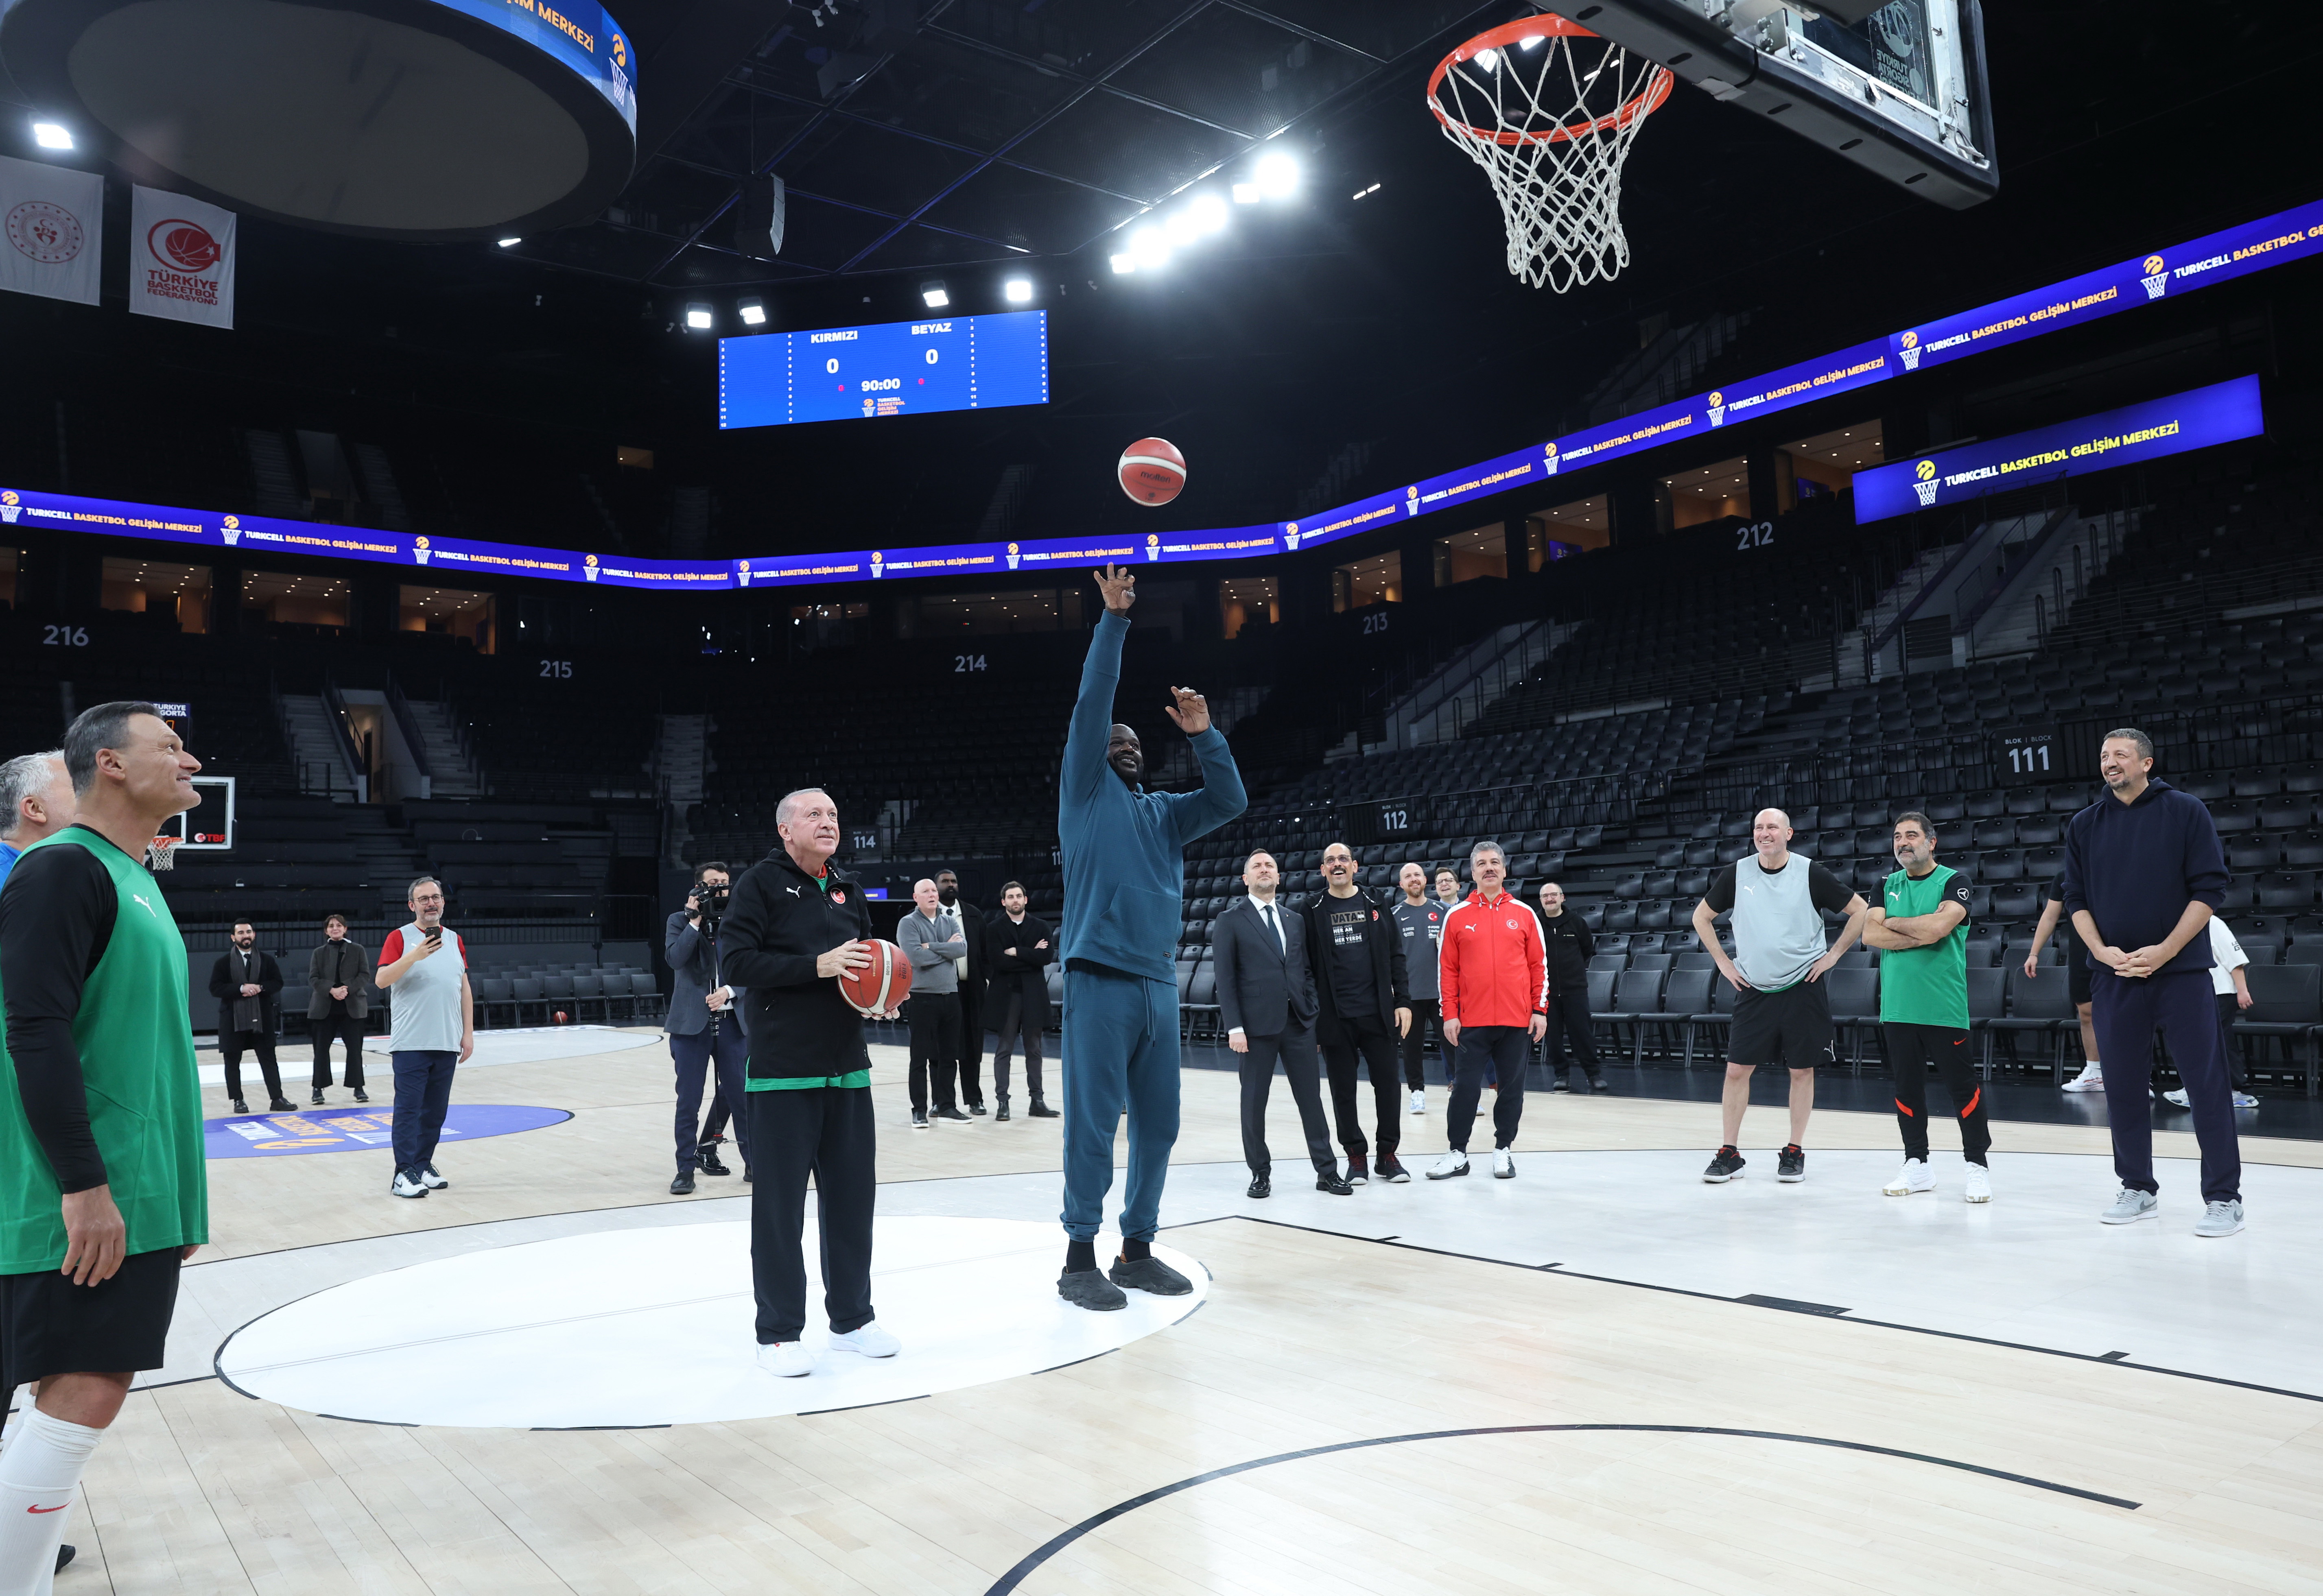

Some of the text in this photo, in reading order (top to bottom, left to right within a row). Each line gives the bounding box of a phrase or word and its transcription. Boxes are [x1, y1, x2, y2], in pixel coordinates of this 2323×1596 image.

[538, 2, 594, 53] MERKEZİ
[2174, 253, 2231, 278] TURKCELL
[2233, 231, 2306, 261] BASKETBOL
[148, 269, 218, 291] TÜRKİYE
[148, 280, 218, 299] BASKETBOL
[148, 288, 218, 306] FEDERASYONU
[911, 322, 952, 335] BEYAZ
[1925, 286, 2118, 353] TURKCELL BASKETBOL GELİŞİM MERKEZİ
[811, 330, 858, 343] KIRMIZI
[826, 358, 839, 374] 0
[925, 349, 938, 365] 0
[861, 378, 900, 392] 90:00
[1728, 356, 1884, 412] TURKCELL BASKETBOL GELİŞİM MERKEZİ
[1561, 414, 1692, 461] TURKCELL BASKETBOL GELİŞİM MERKEZİ
[1944, 419, 2179, 487] TURKCELL BASKETBOL GELİŞİM MERKEZİ
[1141, 471, 1171, 483] molten
[1421, 463, 1531, 504] TURKCELL BASKETBOL GELİŞİM MERKEZİ
[26, 507, 202, 533] TURKCELL BASKETBOL GELİŞİM MERKEZİ
[1301, 504, 1396, 539] TURKCELL BASKETBOL GELİŞİM MERKEZİ
[245, 531, 397, 553] TURKCELL BASKETBOL GELİŞİM MERKEZİ
[1162, 536, 1274, 552] TURKCELL BASKETBOL GELİŞİM MERKEZİ
[1737, 522, 1774, 550] 212
[434, 550, 569, 571] TURKCELL BASKETBOL GELİŞİM MERKEZİ
[885, 555, 994, 570] TURKCELL BASKETBOL GELİŞİM MERKEZİ
[1022, 546, 1134, 561] TURKCELL BASKETBOL GELİŞİM MERKEZİ
[602, 568, 728, 582] TURKCELL BASKETBOL GELİŞİM MERKEZİ
[780, 568, 811, 576] BASKETBOL
[811, 565, 834, 575] GELİŞİM
[834, 563, 858, 573] MERKEZİ
[1363, 612, 1388, 635] 213
[43, 625, 89, 646] 216
[540, 660, 572, 678] 215
[955, 655, 987, 672] 214
[2009, 745, 2049, 773] 111
[1383, 810, 1407, 830] 112
[206, 833, 225, 843] TBF
[854, 835, 876, 849] 114
[1052, 851, 1062, 865] 11
